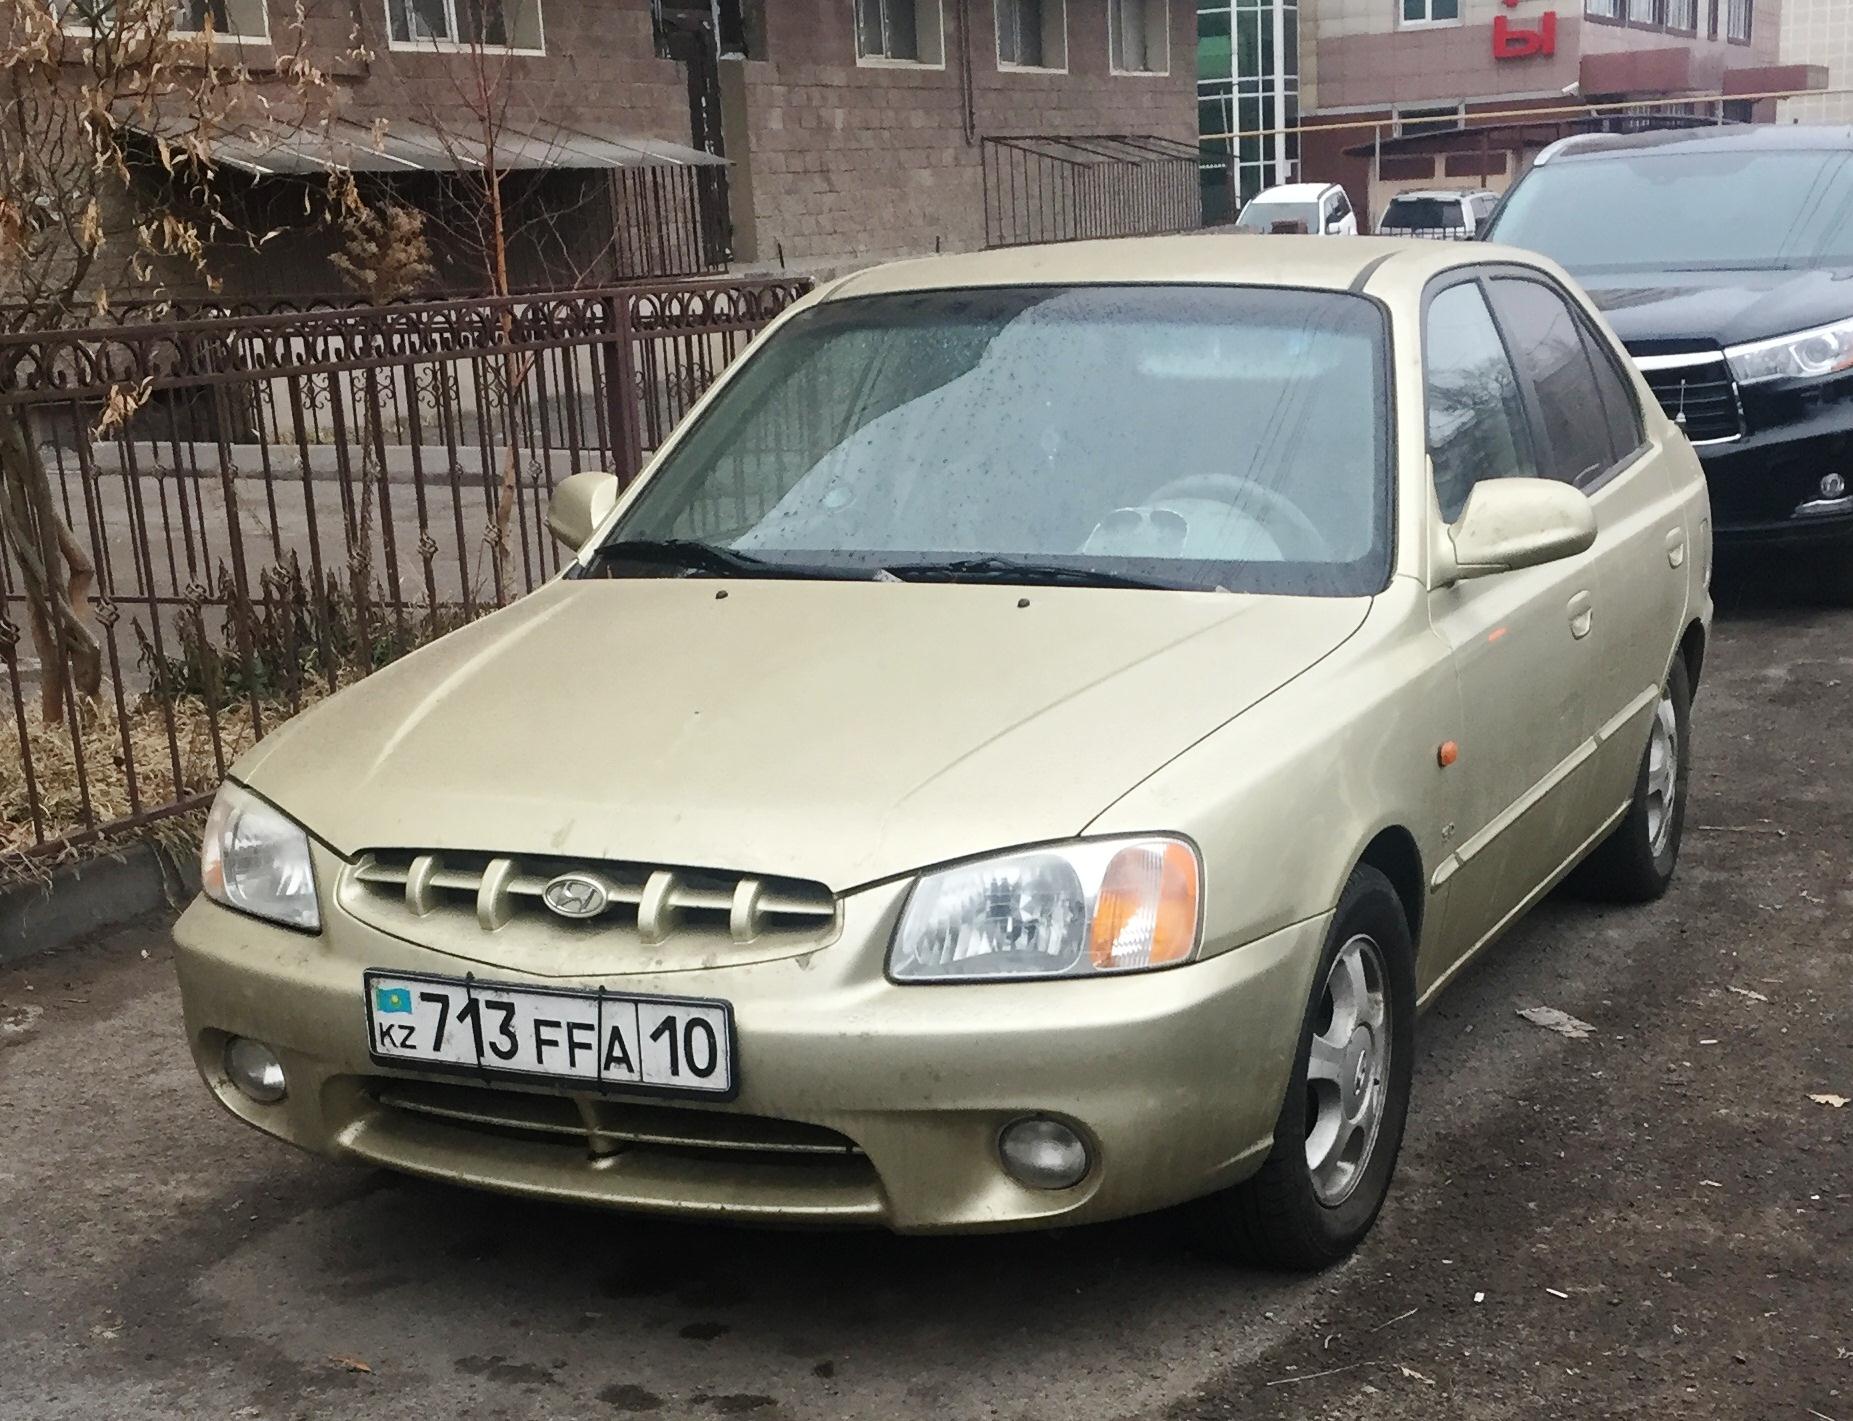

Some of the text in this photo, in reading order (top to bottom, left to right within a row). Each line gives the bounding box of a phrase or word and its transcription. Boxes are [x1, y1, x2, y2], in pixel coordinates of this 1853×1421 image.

[379, 992, 718, 1078] KZ 713 FFA 10
